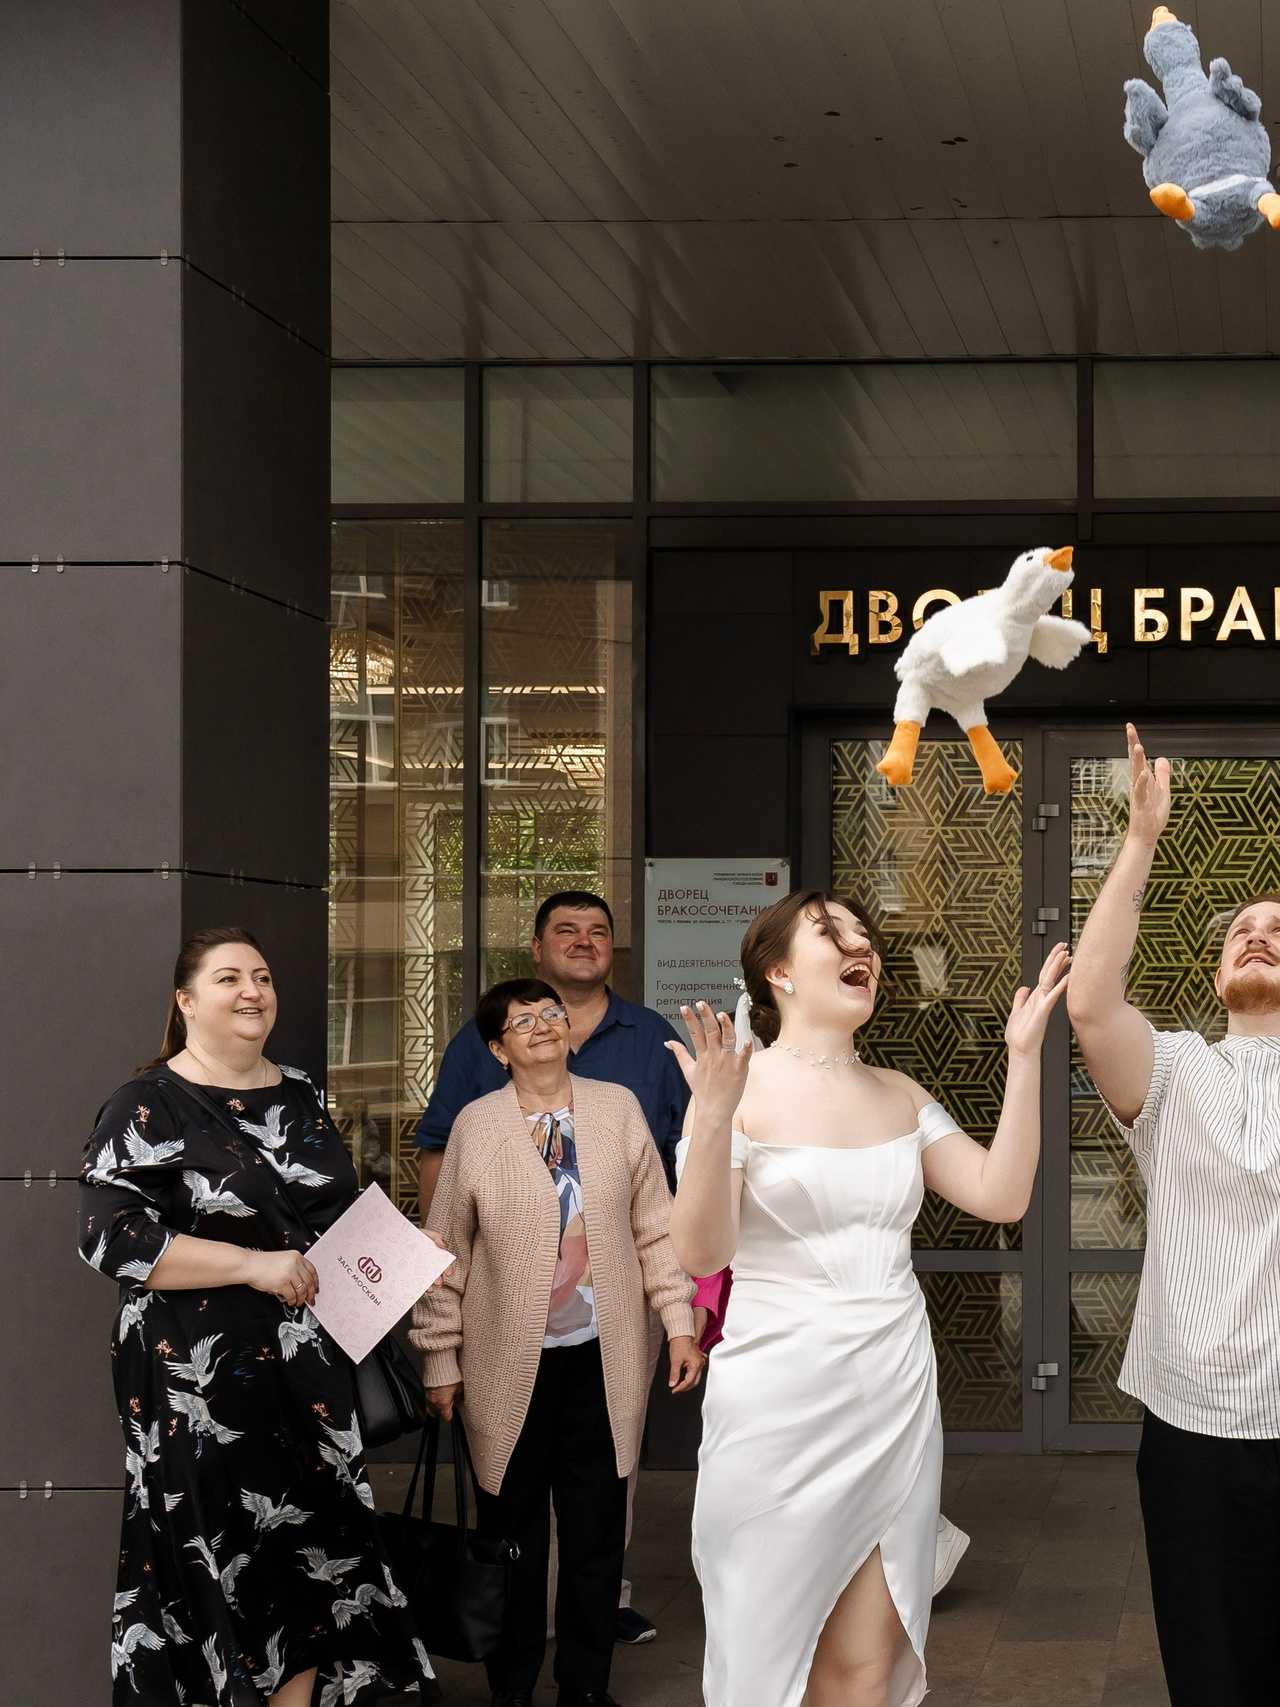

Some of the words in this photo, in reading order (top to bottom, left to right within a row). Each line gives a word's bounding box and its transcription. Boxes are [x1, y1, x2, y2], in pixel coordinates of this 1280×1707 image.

[810, 588, 1109, 656] ДВОЦ
[657, 889, 709, 901] ДВОРЕЦ
[657, 905, 761, 916] БРАКОСОЧЕТАН
[657, 959, 677, 969] ВИД
[678, 959, 742, 969] ДЕЯТЕЛЬНОСТ
[656, 998, 723, 1008] регистрция
[337, 1255, 353, 1275] ЗАГС
[351, 1274, 381, 1306] МОСКВЫ
